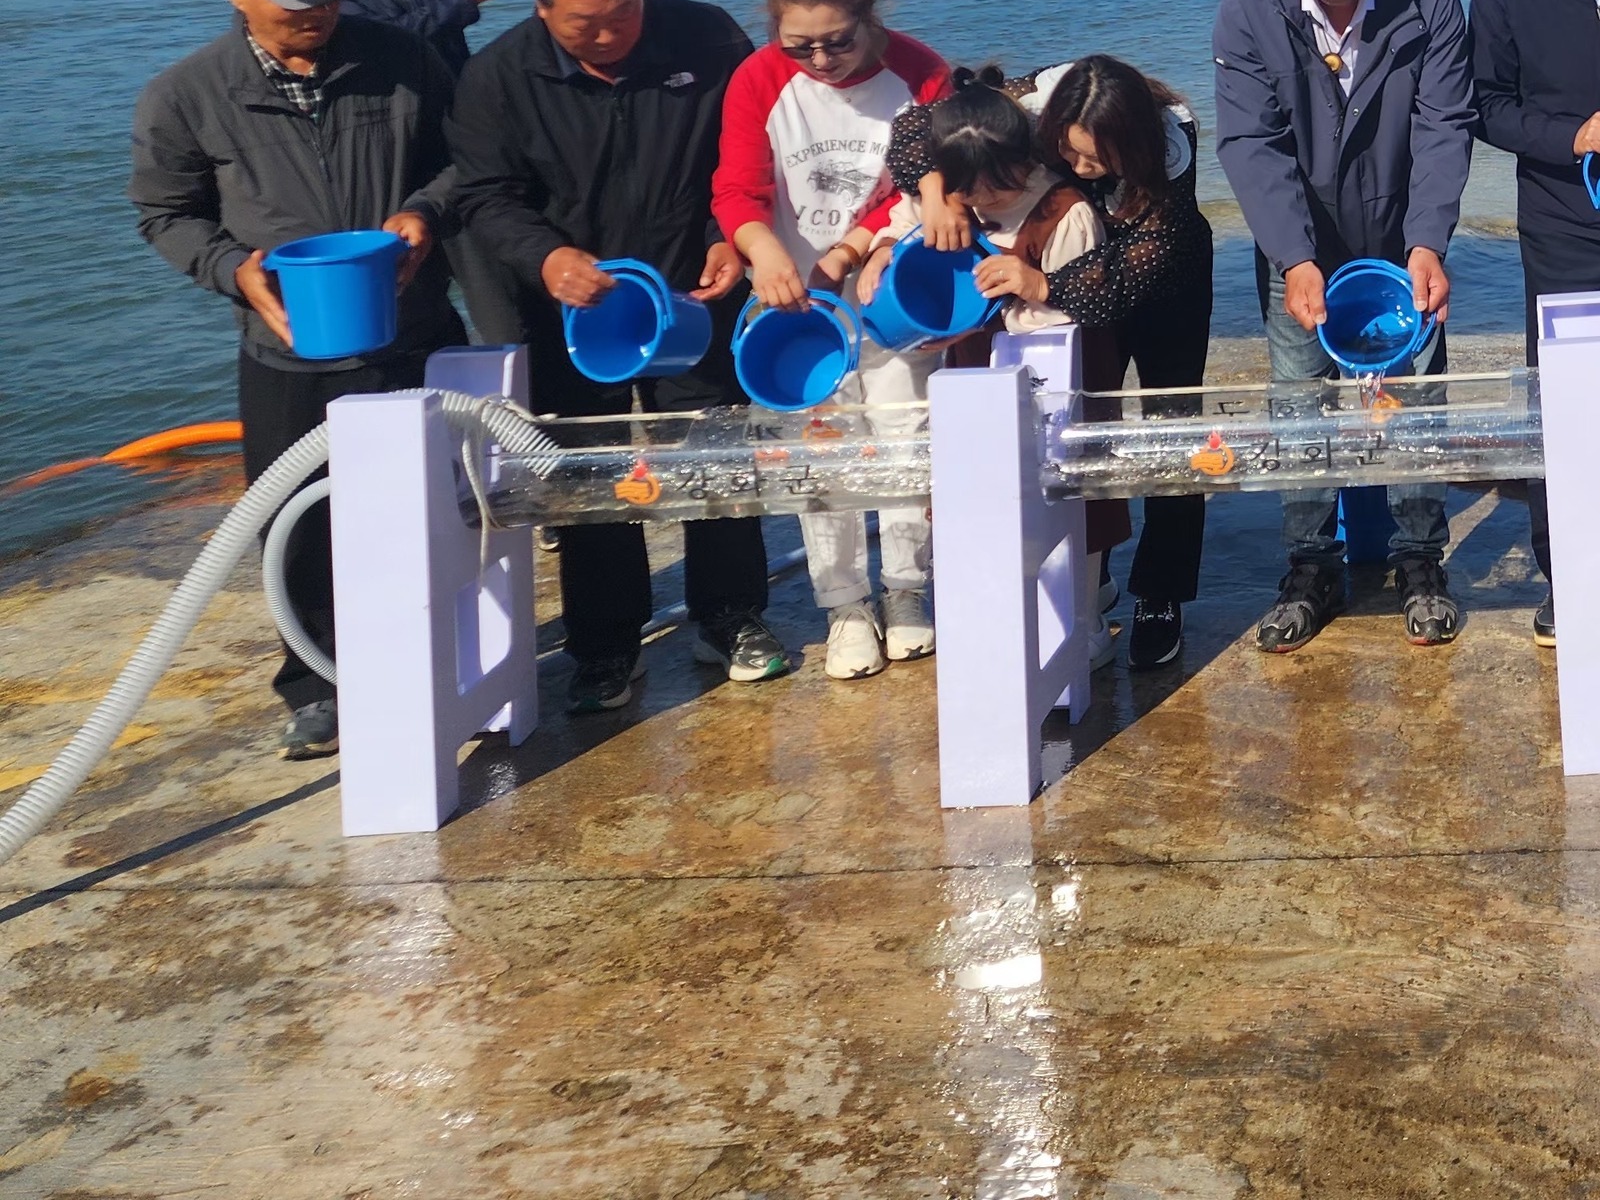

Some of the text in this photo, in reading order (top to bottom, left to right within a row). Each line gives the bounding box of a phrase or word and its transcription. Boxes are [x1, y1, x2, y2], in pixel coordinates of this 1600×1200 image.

[784, 139, 889, 169] EXPERIENCE MO
[675, 464, 819, 500] 강화군
